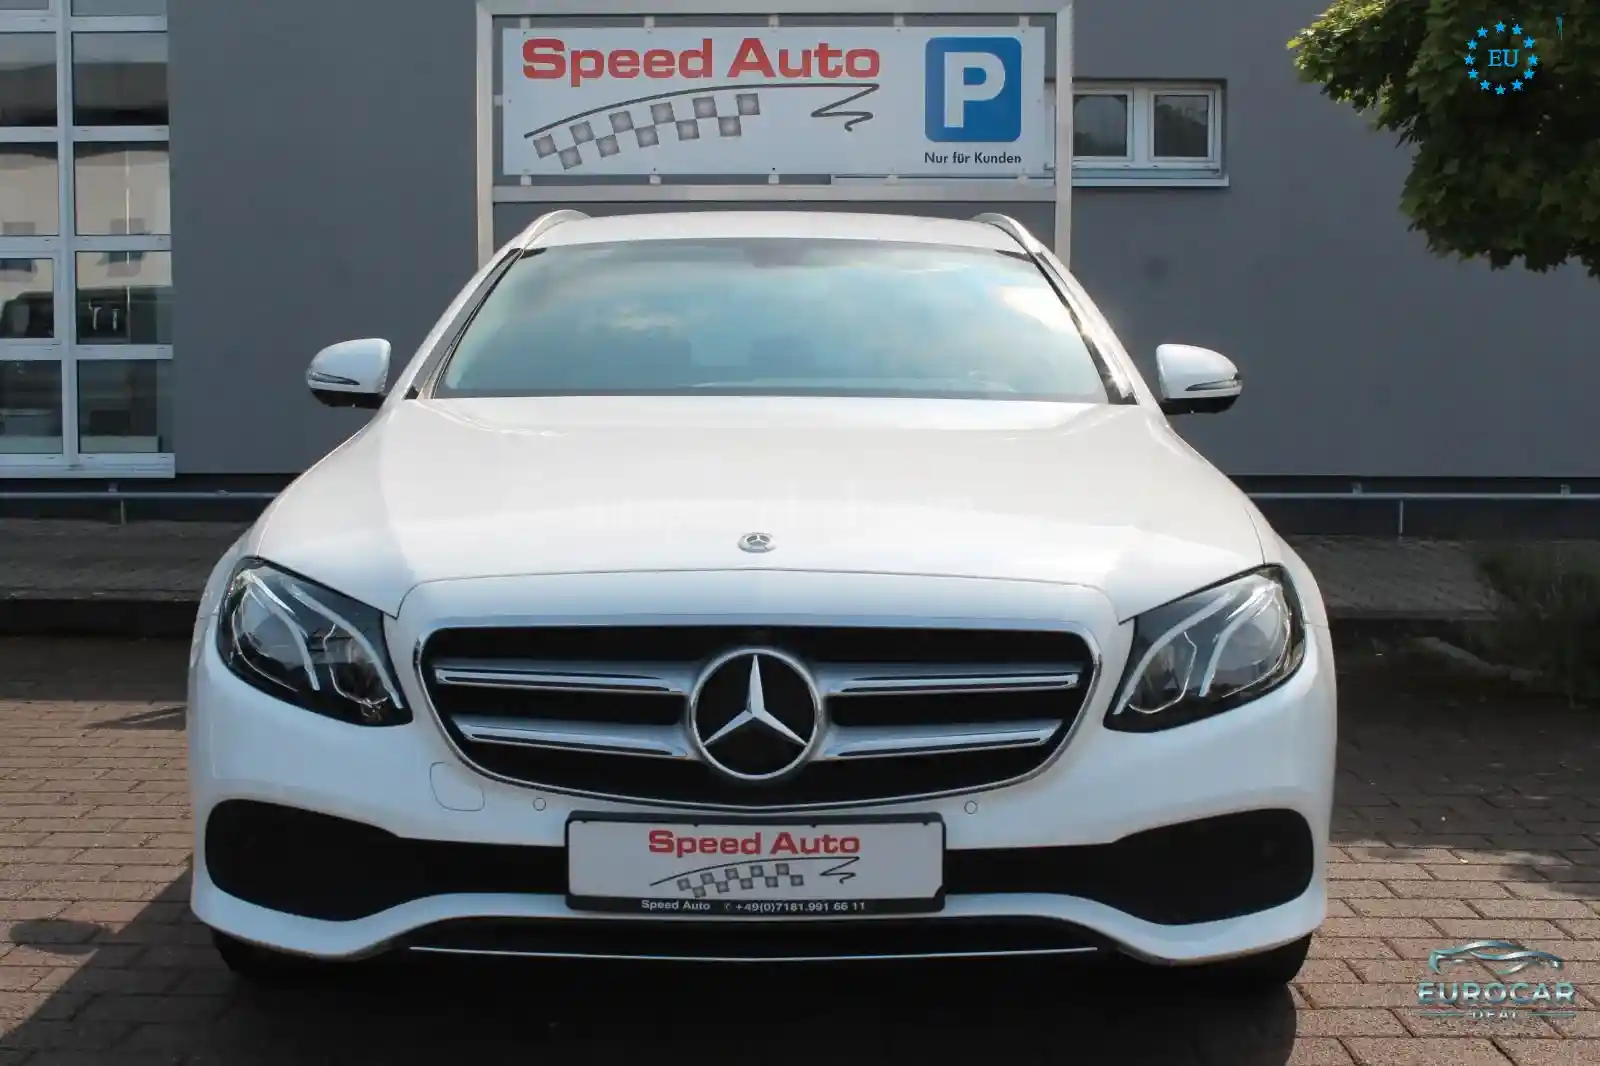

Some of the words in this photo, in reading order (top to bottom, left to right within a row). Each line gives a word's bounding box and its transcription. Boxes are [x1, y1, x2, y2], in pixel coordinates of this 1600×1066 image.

[523, 38, 713, 87] Speed
[727, 37, 880, 78] Auto
[944, 52, 1005, 128] P
[924, 151, 949, 164] Nur
[952, 151, 971, 164] für
[974, 151, 1022, 164] Kunden
[648, 829, 762, 858] Speed
[770, 832, 861, 854] Auto
[641, 900, 679, 910] Speed
[682, 901, 711, 910] Auto
[852, 902, 865, 911] 11
